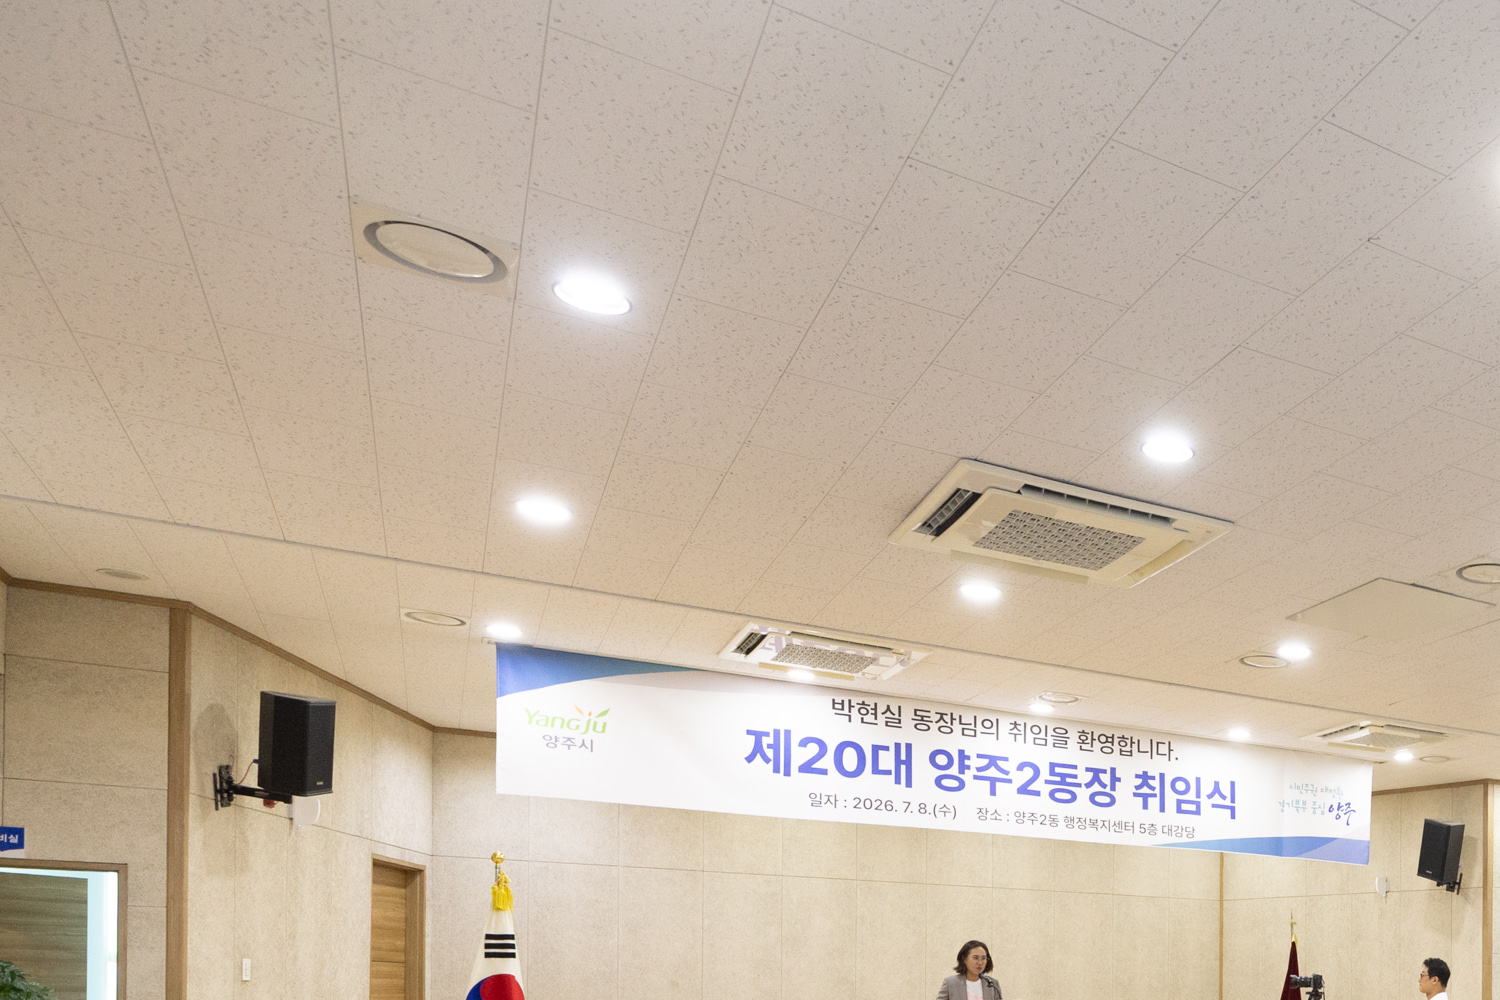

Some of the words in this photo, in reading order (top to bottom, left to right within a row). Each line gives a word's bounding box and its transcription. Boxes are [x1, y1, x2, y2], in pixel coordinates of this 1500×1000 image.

[542, 734, 594, 753] 양주시
[831, 698, 903, 729] 박현실
[911, 708, 1000, 741] 동장님의
[1008, 720, 1071, 750] 취임을
[1076, 729, 1179, 762] 환영합니다.
[744, 728, 913, 789] 제20대
[928, 748, 1122, 808] 양주2동장
[1132, 770, 1236, 820] 취임식
[808, 792, 839, 809] 일자
[852, 797, 898, 812] 2026.
[976, 807, 1003, 822] 장소
[1013, 810, 1060, 828] 양주2동
[1063, 815, 1136, 834] 행정복지센터
[1138, 822, 1159, 836] 5층
[1161, 824, 1196, 839] 대강당
[1328, 801, 1357, 826] 양주
